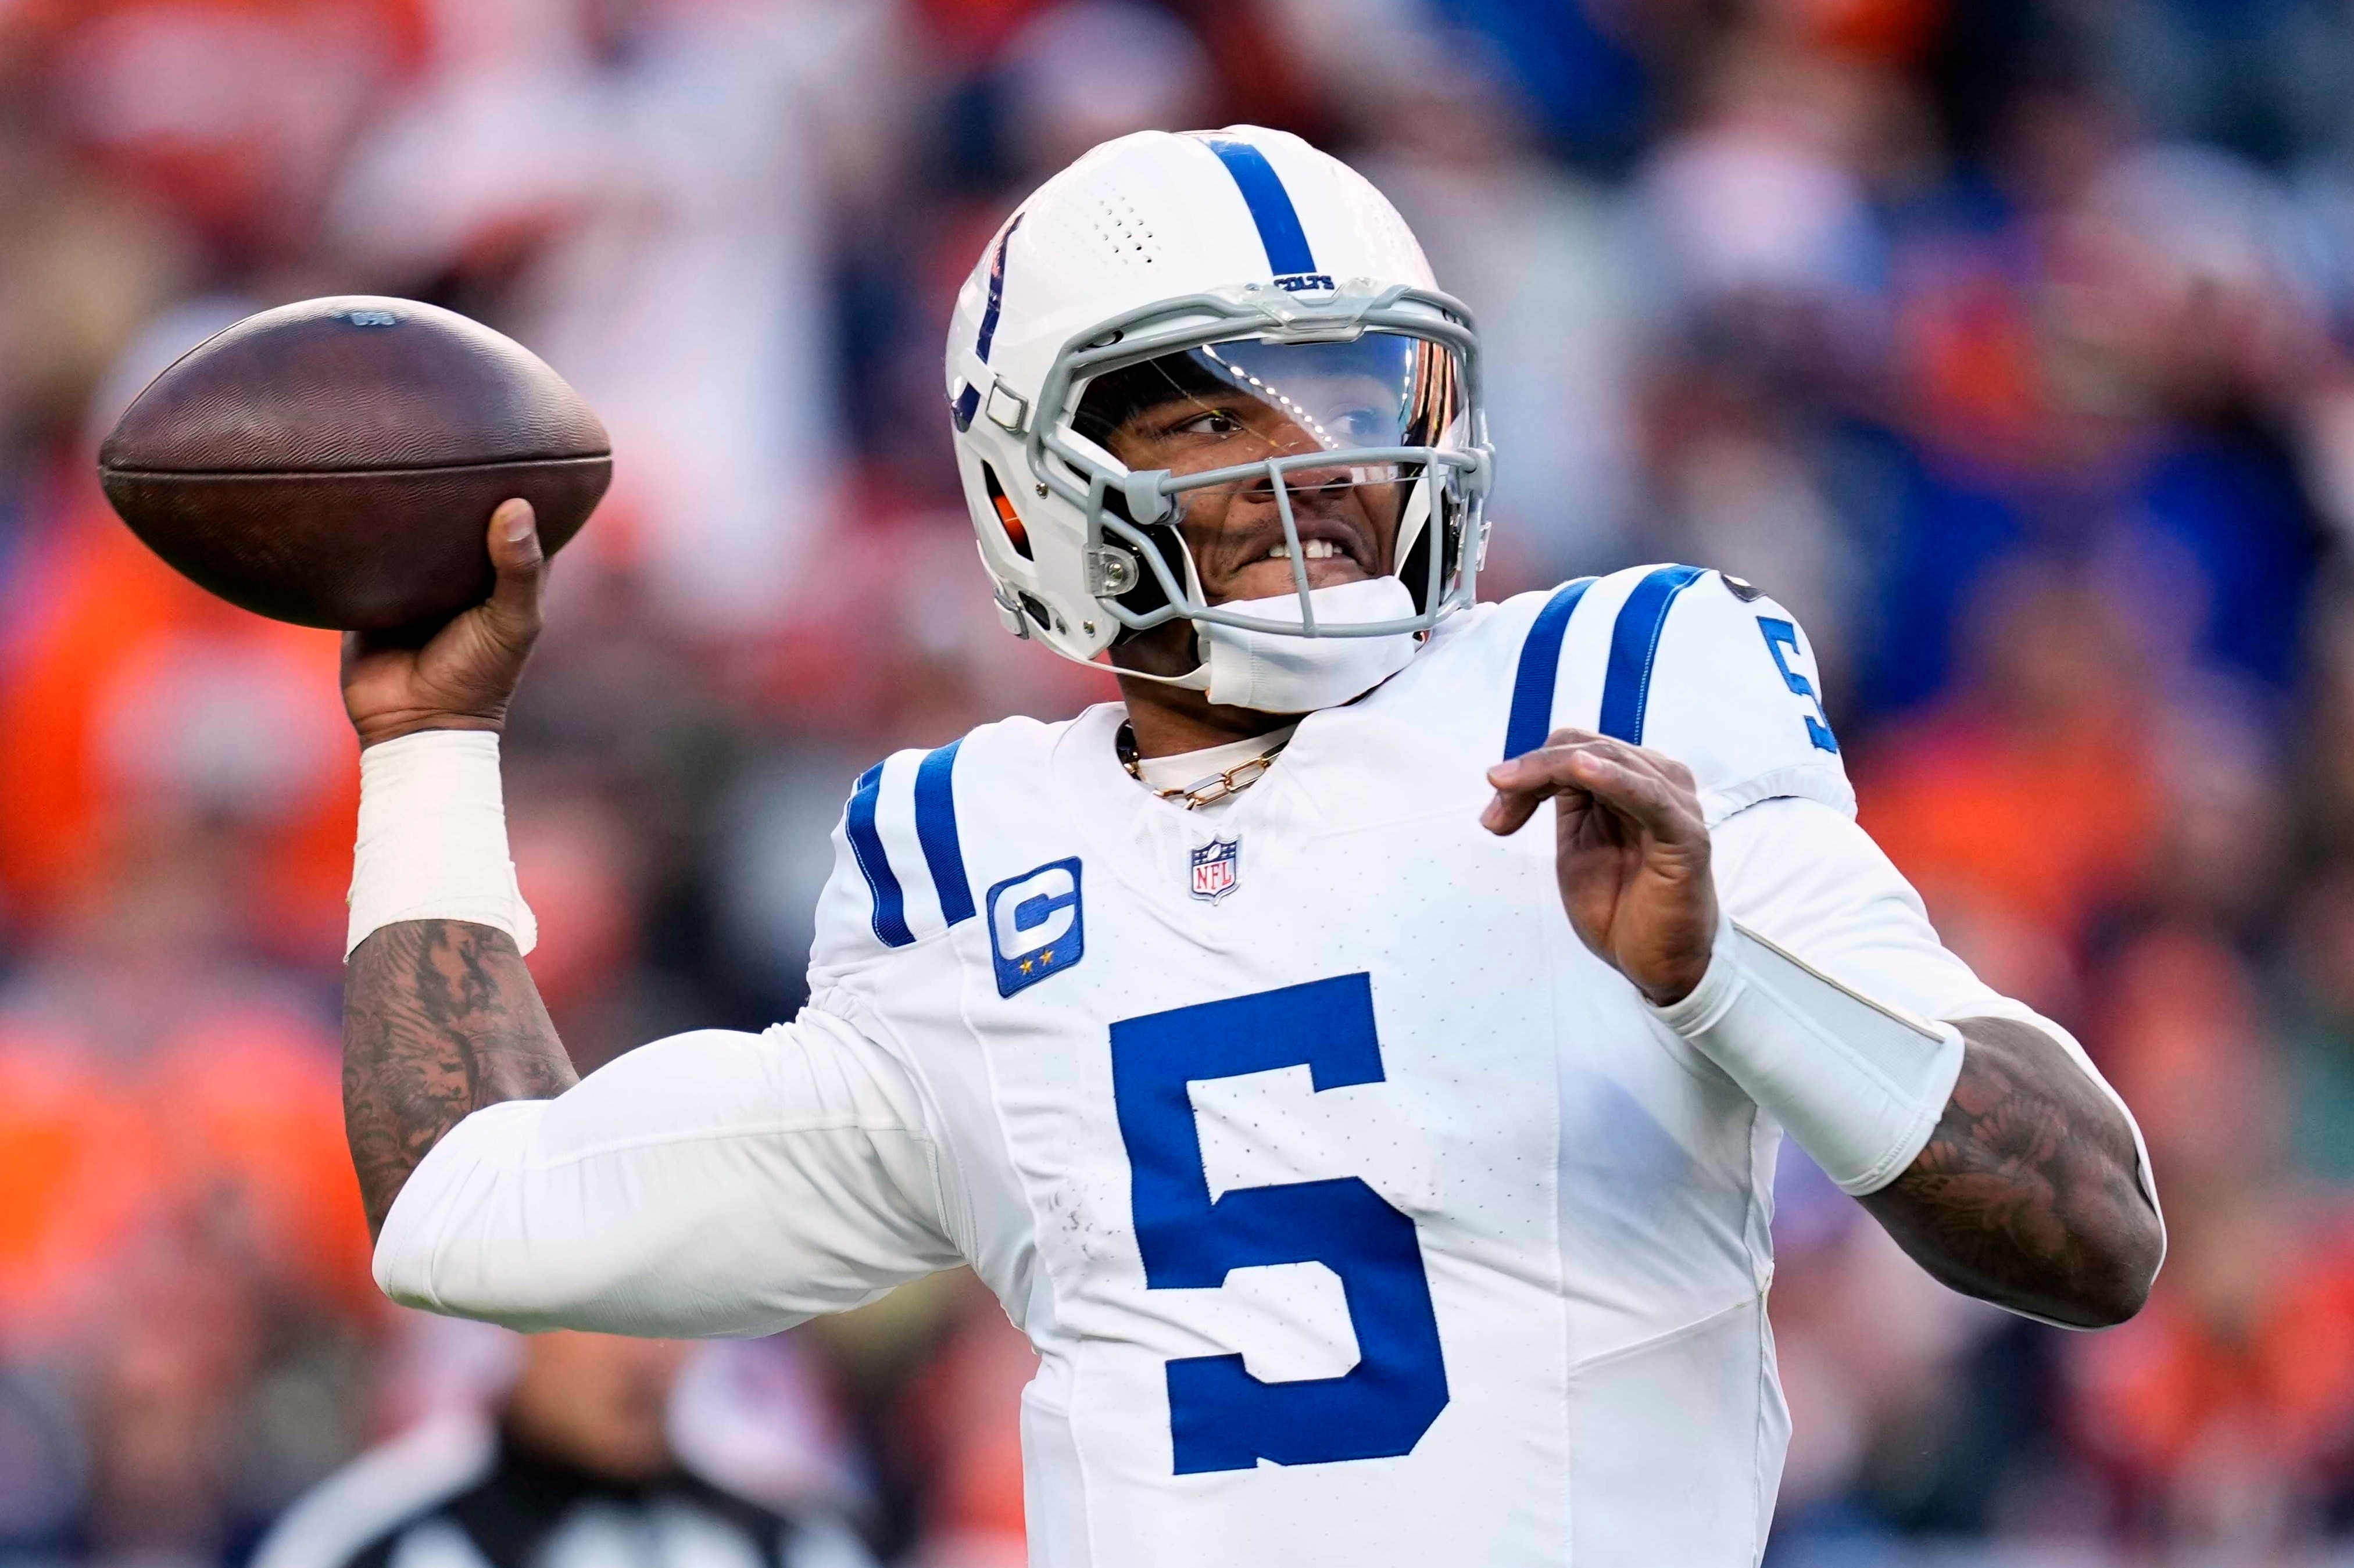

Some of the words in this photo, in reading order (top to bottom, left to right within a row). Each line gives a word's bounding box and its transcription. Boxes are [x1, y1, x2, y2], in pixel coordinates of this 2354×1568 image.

[1756, 615, 1839, 754] 5
[993, 868, 1075, 960] C
[1196, 861, 1231, 889] NFL
[1110, 972, 1450, 1475] 5
